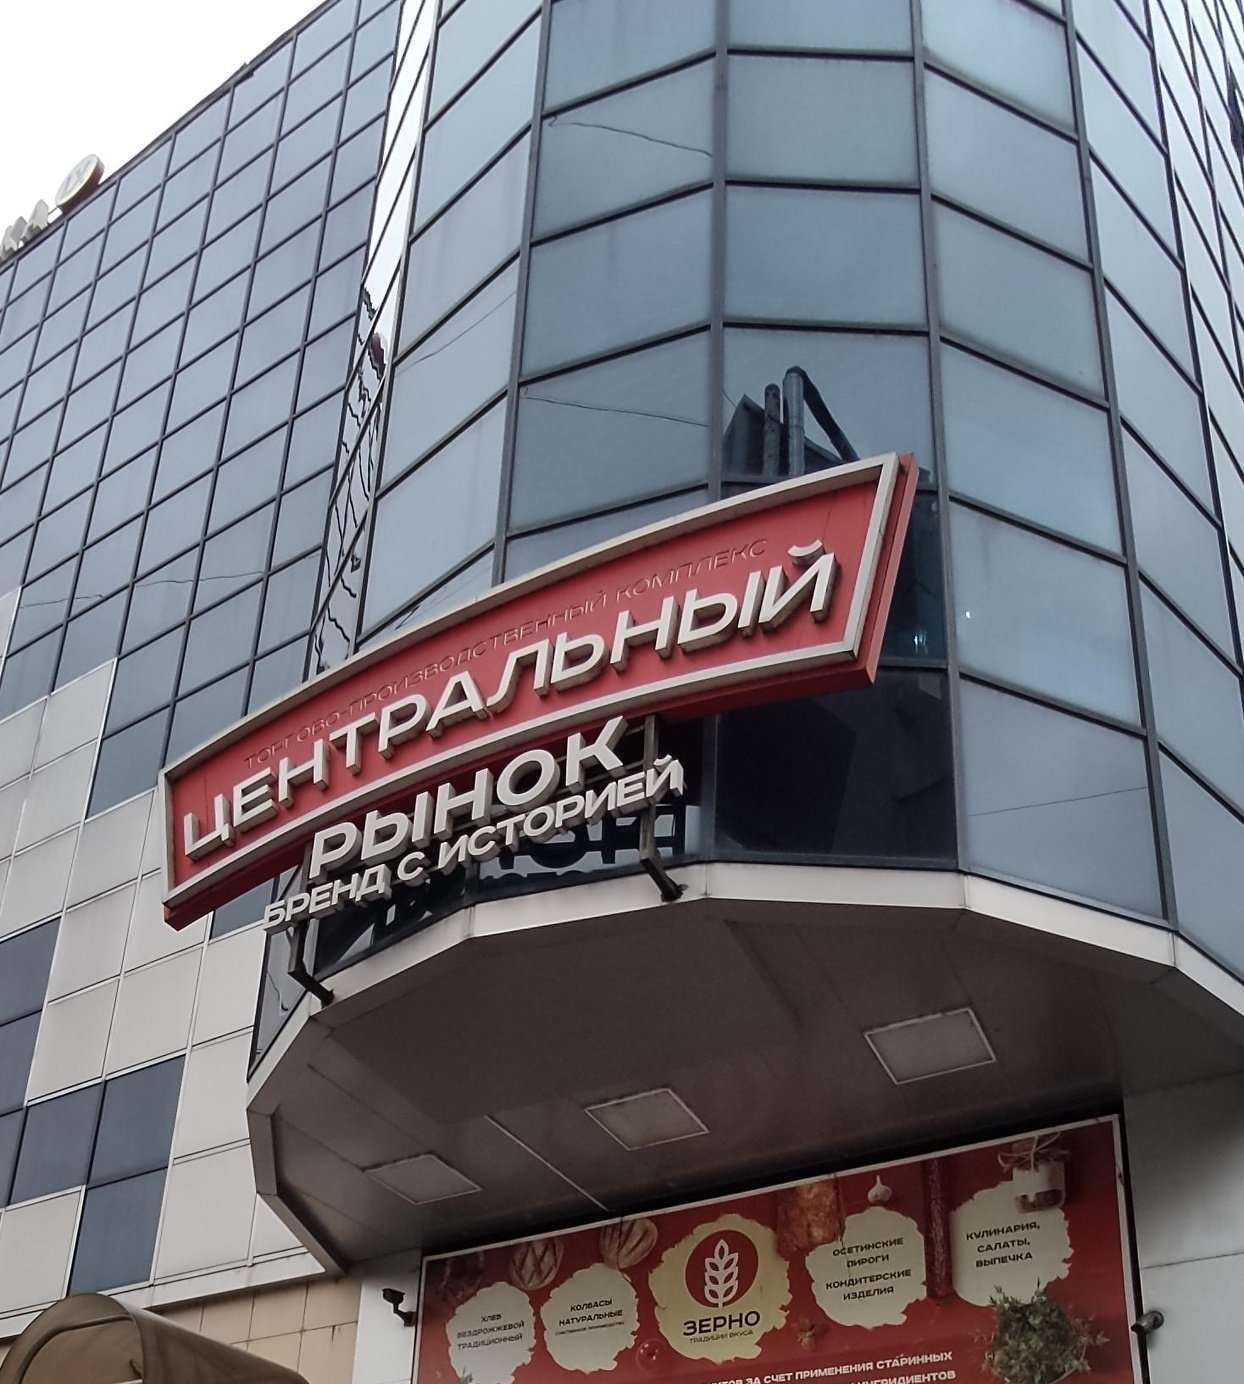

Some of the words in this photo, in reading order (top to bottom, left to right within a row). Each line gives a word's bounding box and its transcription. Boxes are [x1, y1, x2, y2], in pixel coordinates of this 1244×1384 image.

[244, 591, 608, 769] ТОРГОВО-ПРОИЗВОДСТВЕННЫЙ
[616, 538, 768, 601] КОМПЛЕКС
[182, 538, 839, 862] ЦЕНТРАЛЬНЫЙ
[307, 716, 629, 882] РЫНОК
[264, 861, 393, 933] БРЕНД
[396, 851, 432, 888] С
[437, 754, 685, 877] ИСТОРИЕЙ
[966, 1221, 1040, 1241] КУЛИНАРИЯ,
[832, 1237, 904, 1256] ОСЕТИНСКИЕ
[976, 1237, 1031, 1254] САЛАТЫ,
[846, 1254, 890, 1269] ПИРОГИ
[975, 1251, 1033, 1268] ВЫПЕЧКА
[825, 1269, 912, 1290] КОНДИТЕРСКИЕ
[843, 1286, 894, 1301] ИЗДЕЛИЯ
[570, 1298, 613, 1312] КОЛБАСЫ
[481, 1313, 503, 1322] ХЛЕБ
[559, 1309, 623, 1327] НАТУРАЛЬНЫЕ
[683, 1311, 760, 1336] ЗЕРНО
[763, 1372, 793, 1384] СЧЕТ
[795, 1362, 874, 1380] ПРИМЕНЕНИЯ
[876, 1351, 953, 1370] СТАРИННЫХ
